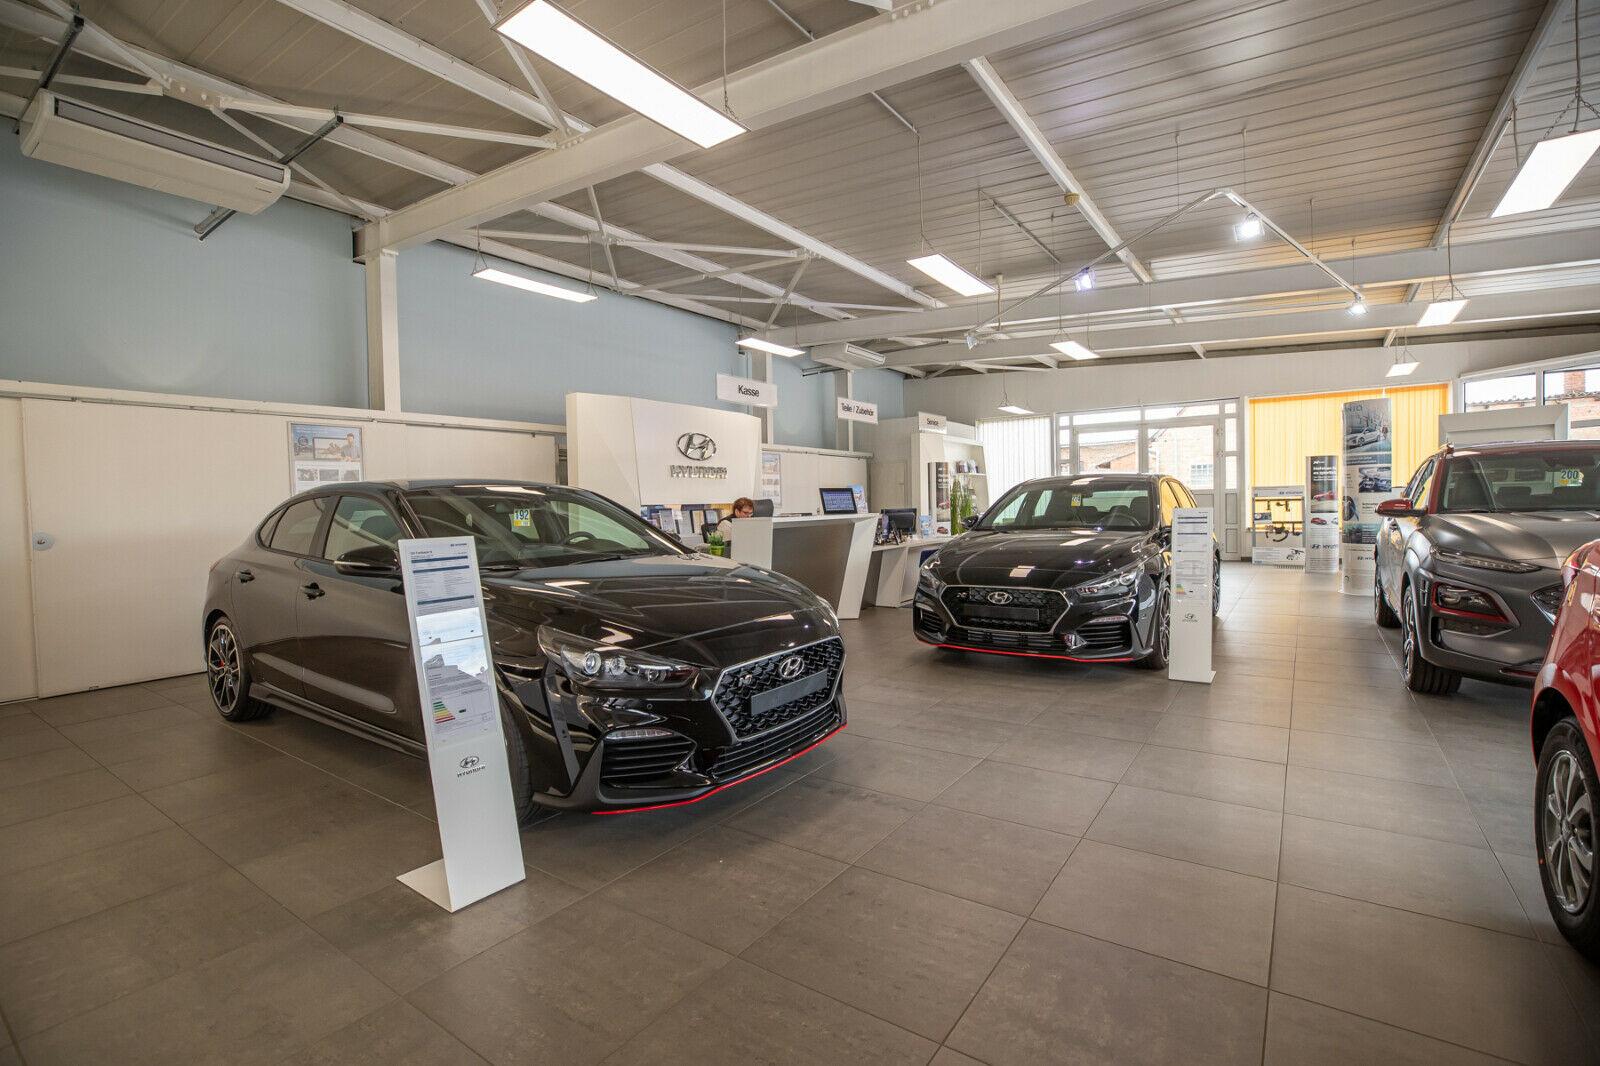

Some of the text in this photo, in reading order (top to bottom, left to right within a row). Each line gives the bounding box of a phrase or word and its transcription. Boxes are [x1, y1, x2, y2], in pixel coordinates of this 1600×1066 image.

[738, 384, 760, 397] Kasse
[670, 464, 727, 480] HYUNDAI
[1561, 469, 1579, 480] 200
